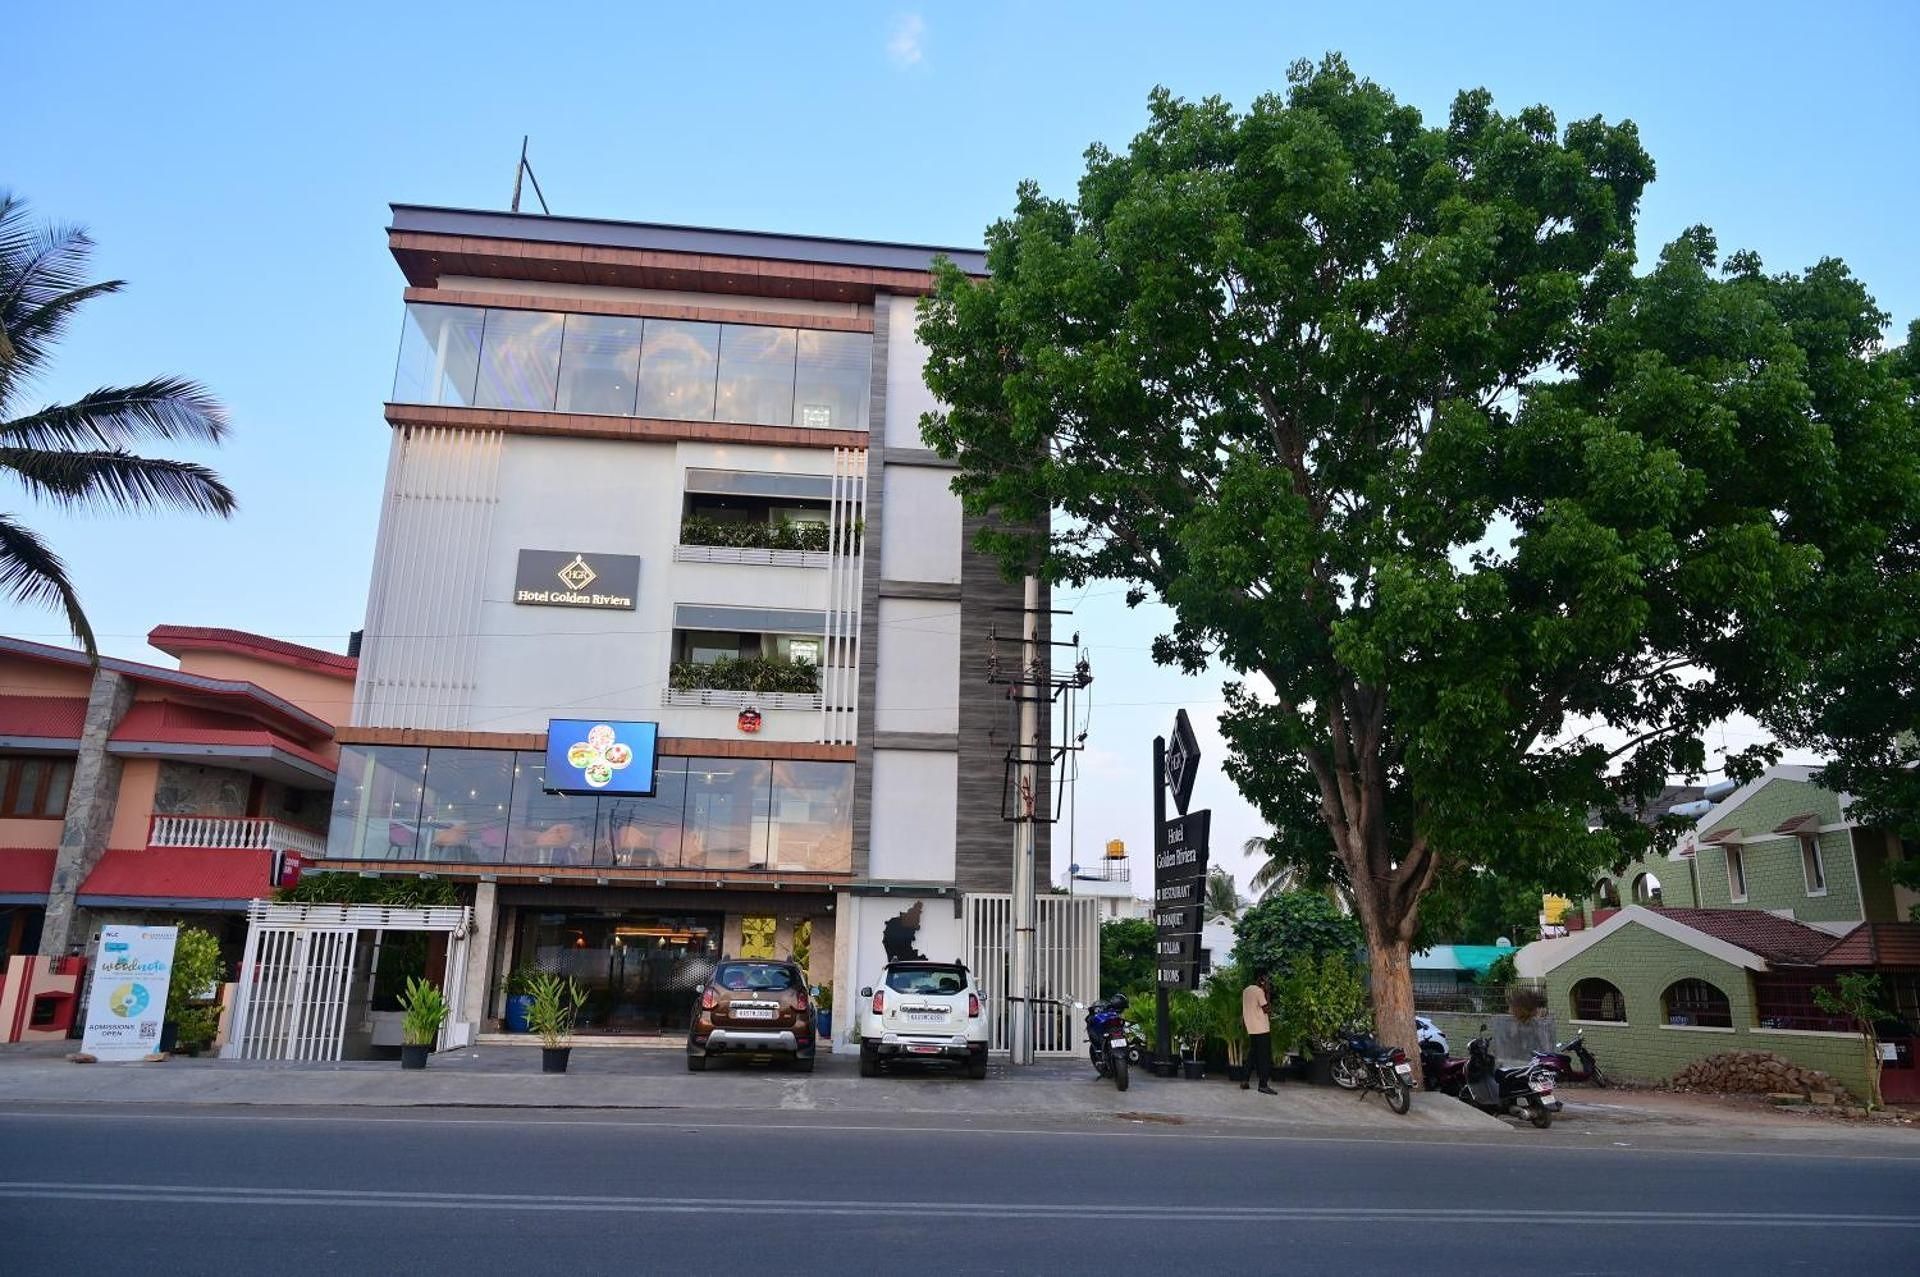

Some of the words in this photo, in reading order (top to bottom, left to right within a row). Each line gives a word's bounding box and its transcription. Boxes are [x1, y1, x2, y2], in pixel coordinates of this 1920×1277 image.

[518, 590, 549, 602] Hotel
[550, 592, 590, 604] Golden
[592, 595, 631, 606] Riviera
[1167, 824, 1184, 844] Hotel
[1156, 850, 1175, 869] Golden
[1176, 847, 1197, 866] Riviera
[1161, 884, 1191, 900] RESTAURANT
[1161, 912, 1184, 929] BANQUET
[1162, 967, 1180, 983] ROOMS
[88, 1023, 136, 1031] ADMISSIONS
